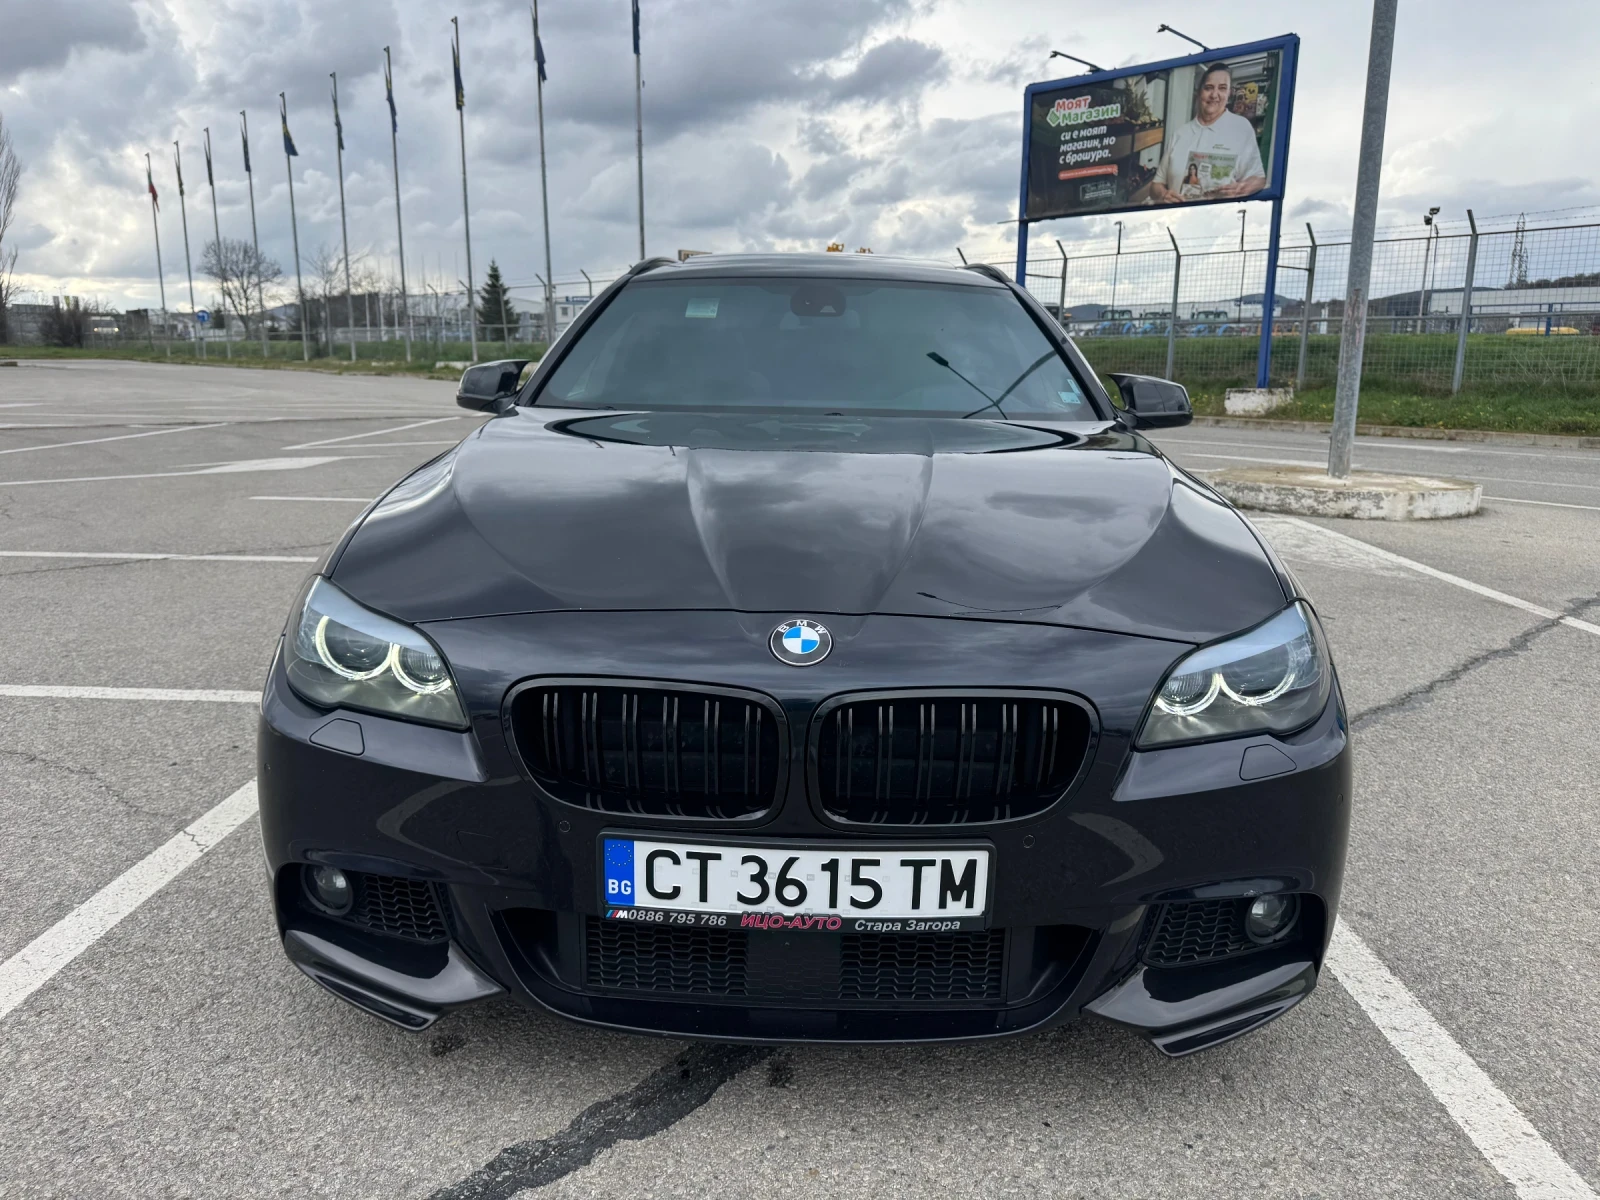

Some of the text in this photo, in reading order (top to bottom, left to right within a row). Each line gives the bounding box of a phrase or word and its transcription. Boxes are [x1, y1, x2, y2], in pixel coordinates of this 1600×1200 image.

[1060, 125, 1107, 141] си е моят
[1060, 136, 1116, 153] магазин, но
[1059, 149, 1112, 166] с брошура.
[778, 619, 827, 634] BMW
[608, 878, 632, 895] BG
[645, 849, 978, 910] CT 3615 TM
[668, 913, 696, 924] 795
[700, 914, 727, 926] 786
[739, 912, 842, 930] ИЦО-АУТО
[854, 919, 961, 932] Стара Загора
